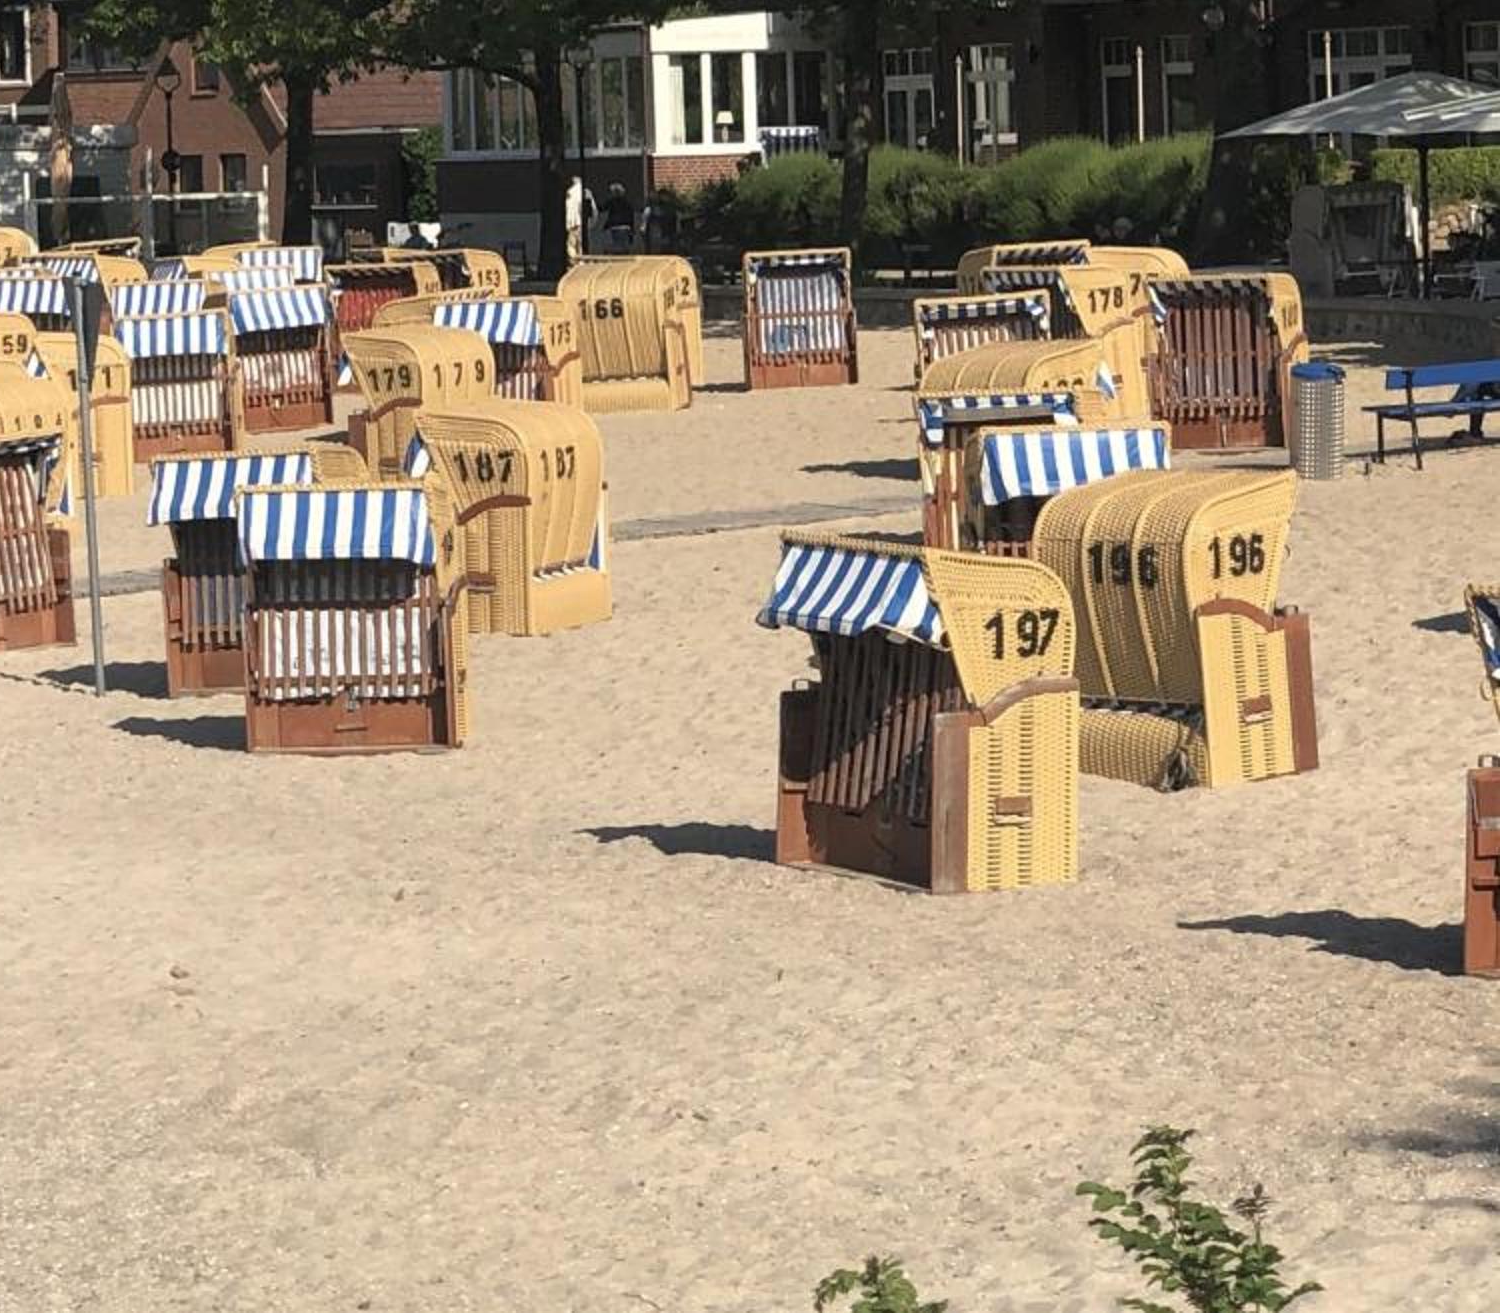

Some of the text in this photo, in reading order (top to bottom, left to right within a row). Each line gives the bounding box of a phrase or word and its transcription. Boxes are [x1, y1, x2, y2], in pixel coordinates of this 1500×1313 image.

[477, 270, 500, 288] 153
[578, 298, 623, 321] 166
[1088, 286, 1123, 313] 178
[368, 366, 412, 392] 179
[433, 359, 485, 388] 179
[454, 448, 514, 484] 187
[540, 445, 575, 482] 187
[1086, 540, 1159, 588] 196
[1208, 533, 1265, 579] 196
[985, 607, 1061, 660] 197
